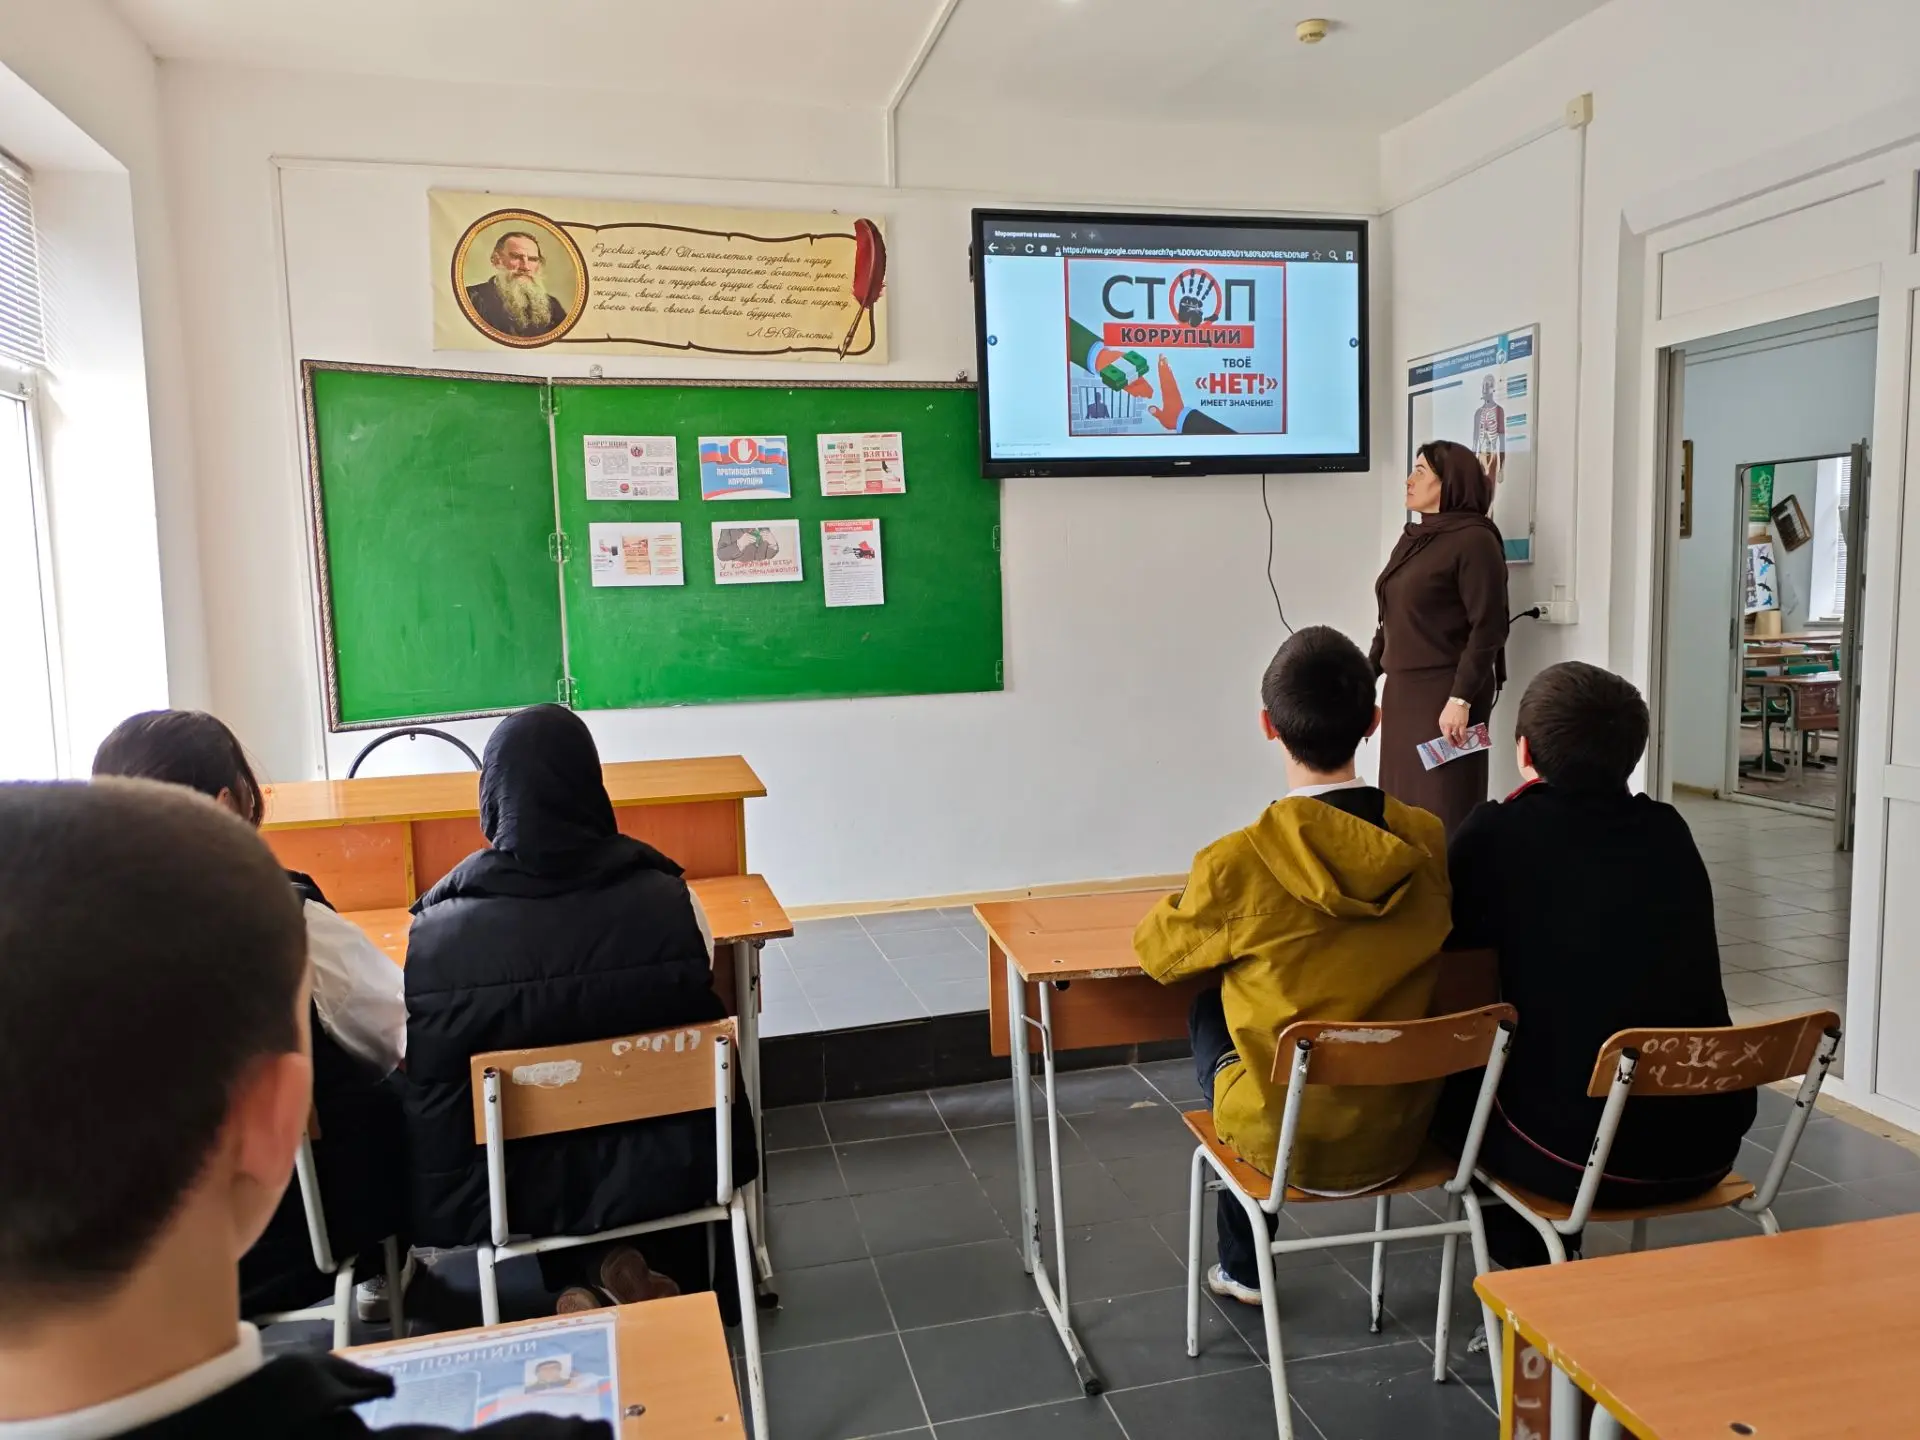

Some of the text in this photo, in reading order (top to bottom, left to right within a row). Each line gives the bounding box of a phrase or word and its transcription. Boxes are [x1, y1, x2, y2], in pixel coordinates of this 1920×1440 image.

[592, 242, 832, 268] Русский язык! Тысячелетия создавал народ
[700, 266, 767, 278] неисчерпаемо
[592, 273, 655, 285] поэтическое
[668, 276, 717, 290] трудовое
[719, 281, 753, 292] орудие
[756, 279, 784, 290] своей
[786, 283, 841, 293] социальной
[635, 287, 663, 299] своей
[708, 291, 736, 303] своих
[780, 294, 808, 306] своих
[1102, 268, 1256, 325] СТОП
[593, 300, 626, 311] своего
[663, 303, 695, 314] своего
[699, 304, 743, 316] великого
[1121, 327, 1241, 347] КОРРУПЦИИ
[1222, 355, 1252, 369] ТВОЁ
[1195, 372, 1279, 395] «НЕТ!»
[1200, 398, 1274, 408] ИМЕЕТ ЗНАЧЕНИЕ!
[863, 449, 898, 459] ВЗЯТКА
[717, 467, 774, 476] ПРОТИВОДЕЙСТВИЕ
[420, 1341, 537, 1371] ПОМНИЛИ
